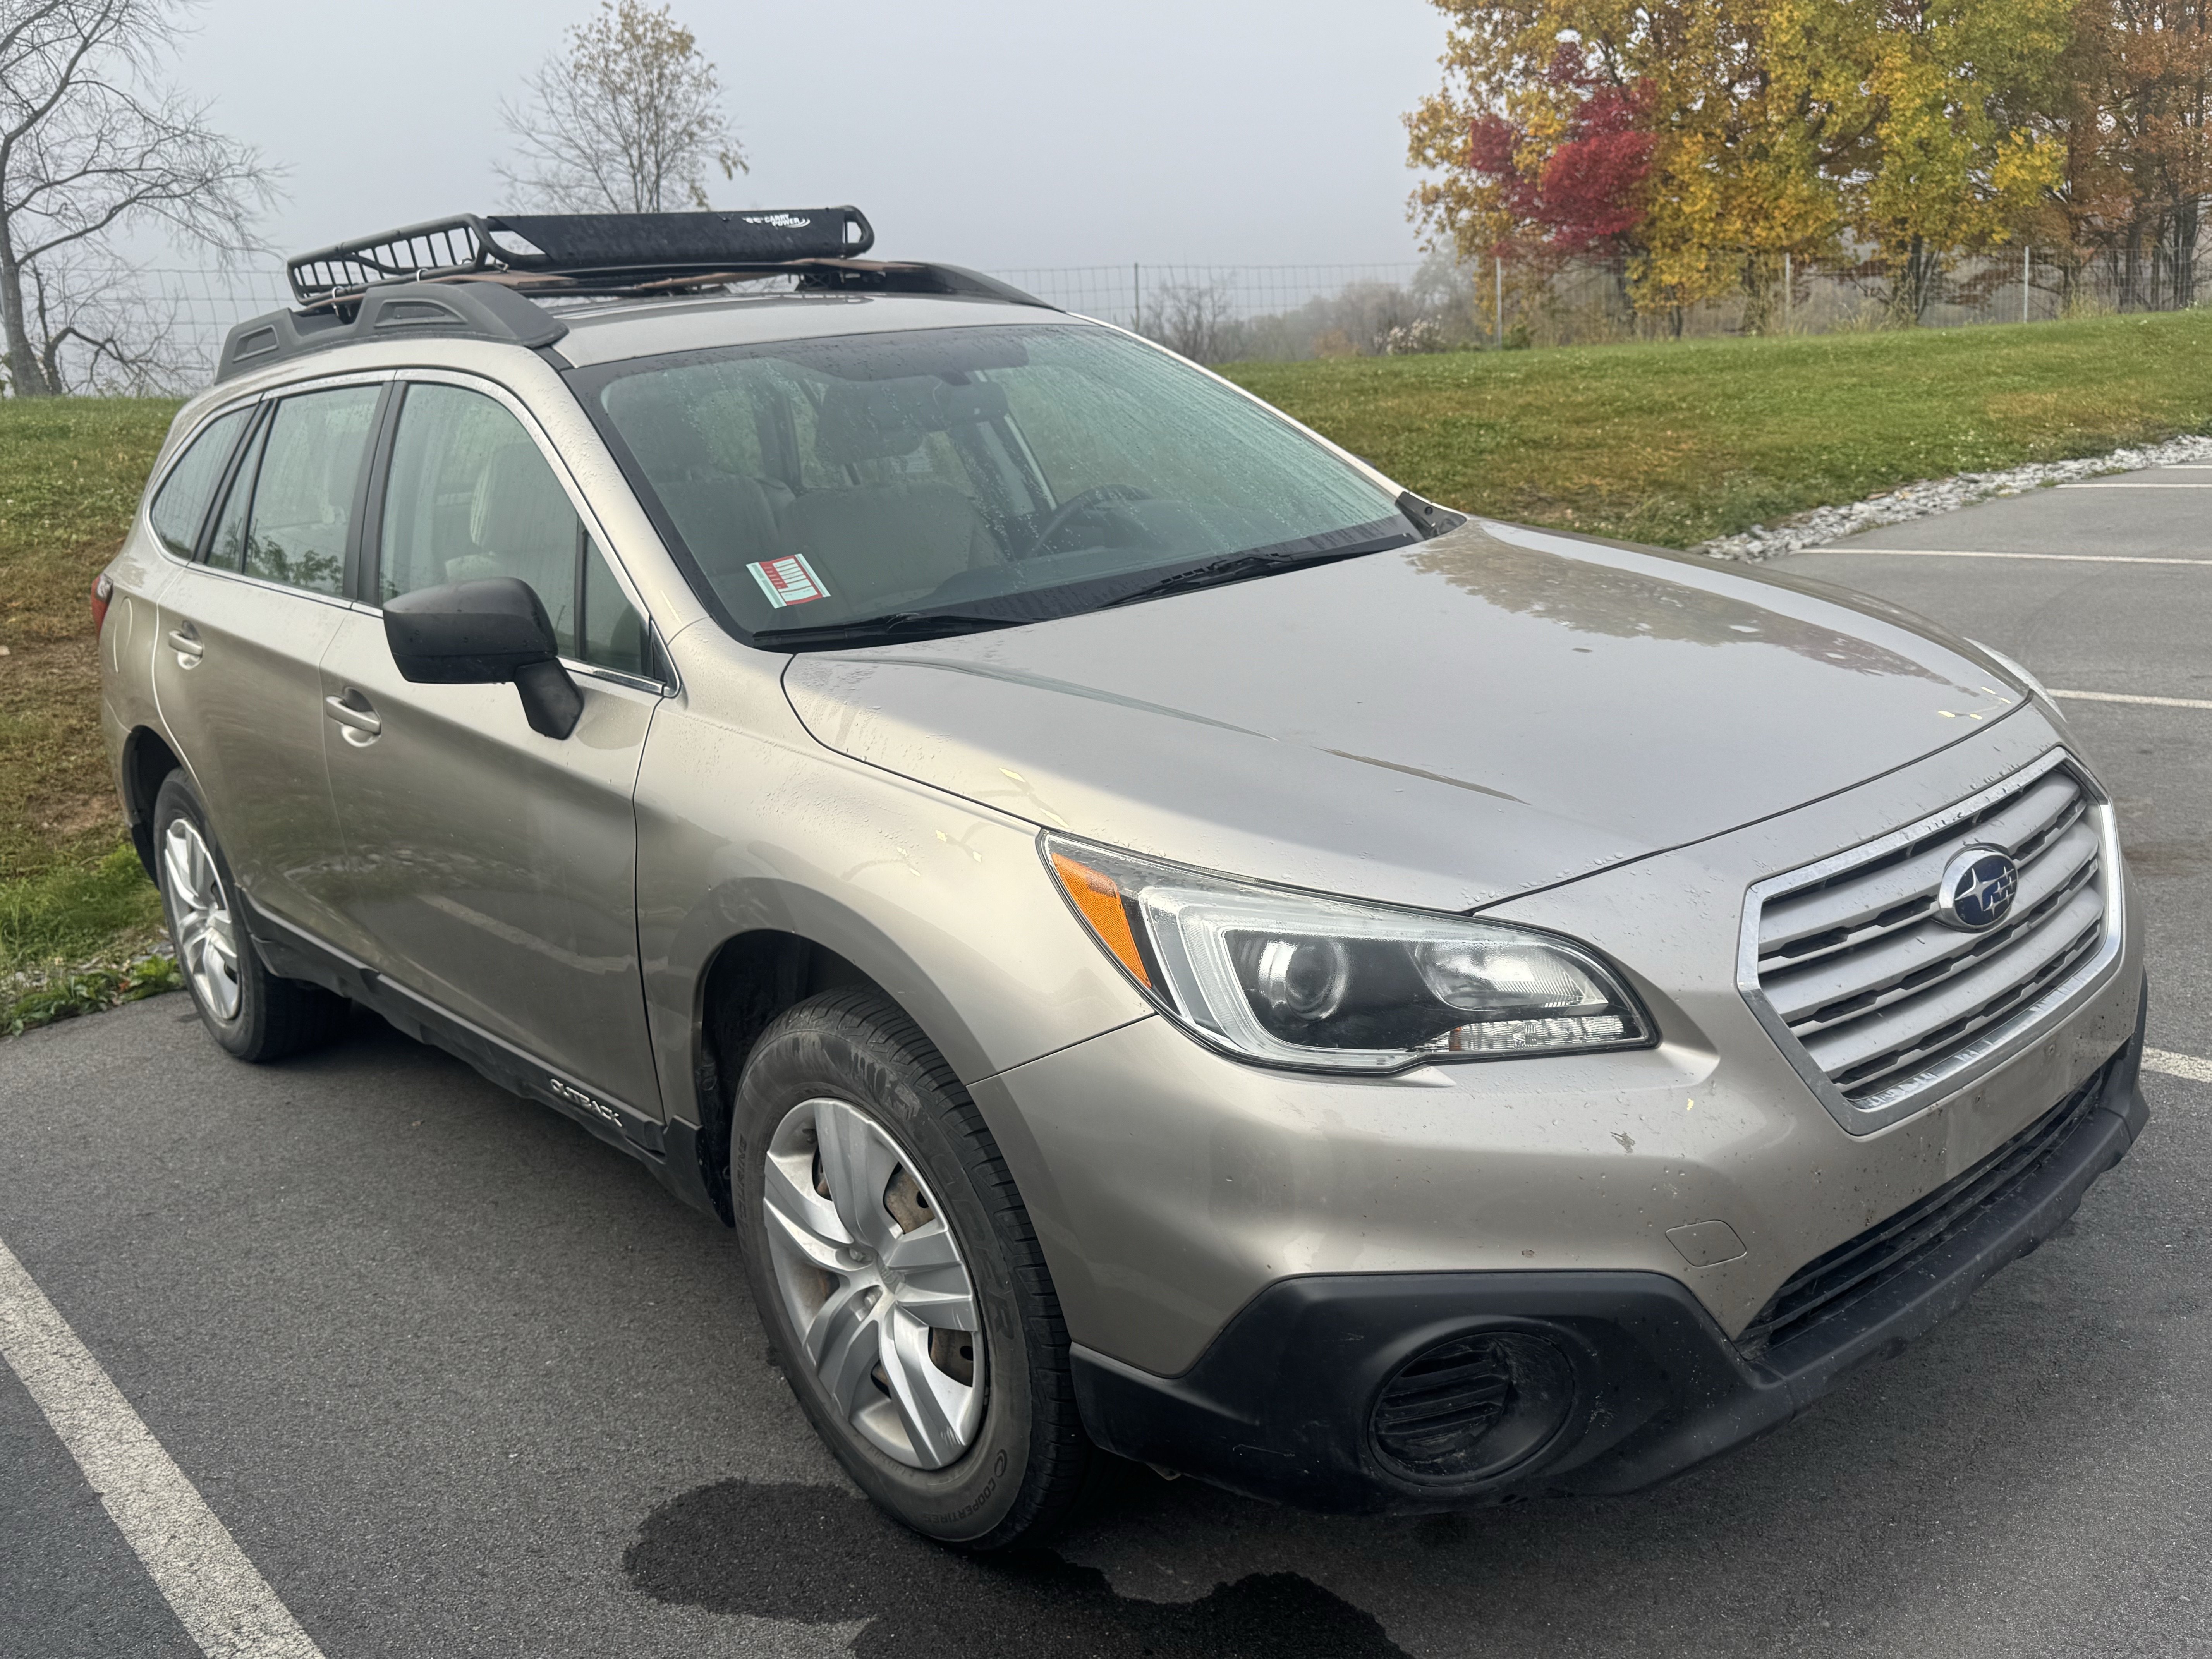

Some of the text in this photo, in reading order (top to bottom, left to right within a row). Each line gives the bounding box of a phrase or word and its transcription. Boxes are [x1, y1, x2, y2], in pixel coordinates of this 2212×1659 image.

[764, 213, 789, 223] CARRY
[772, 218, 800, 227] POWER
[550, 1079, 622, 1127] OUTBACK
